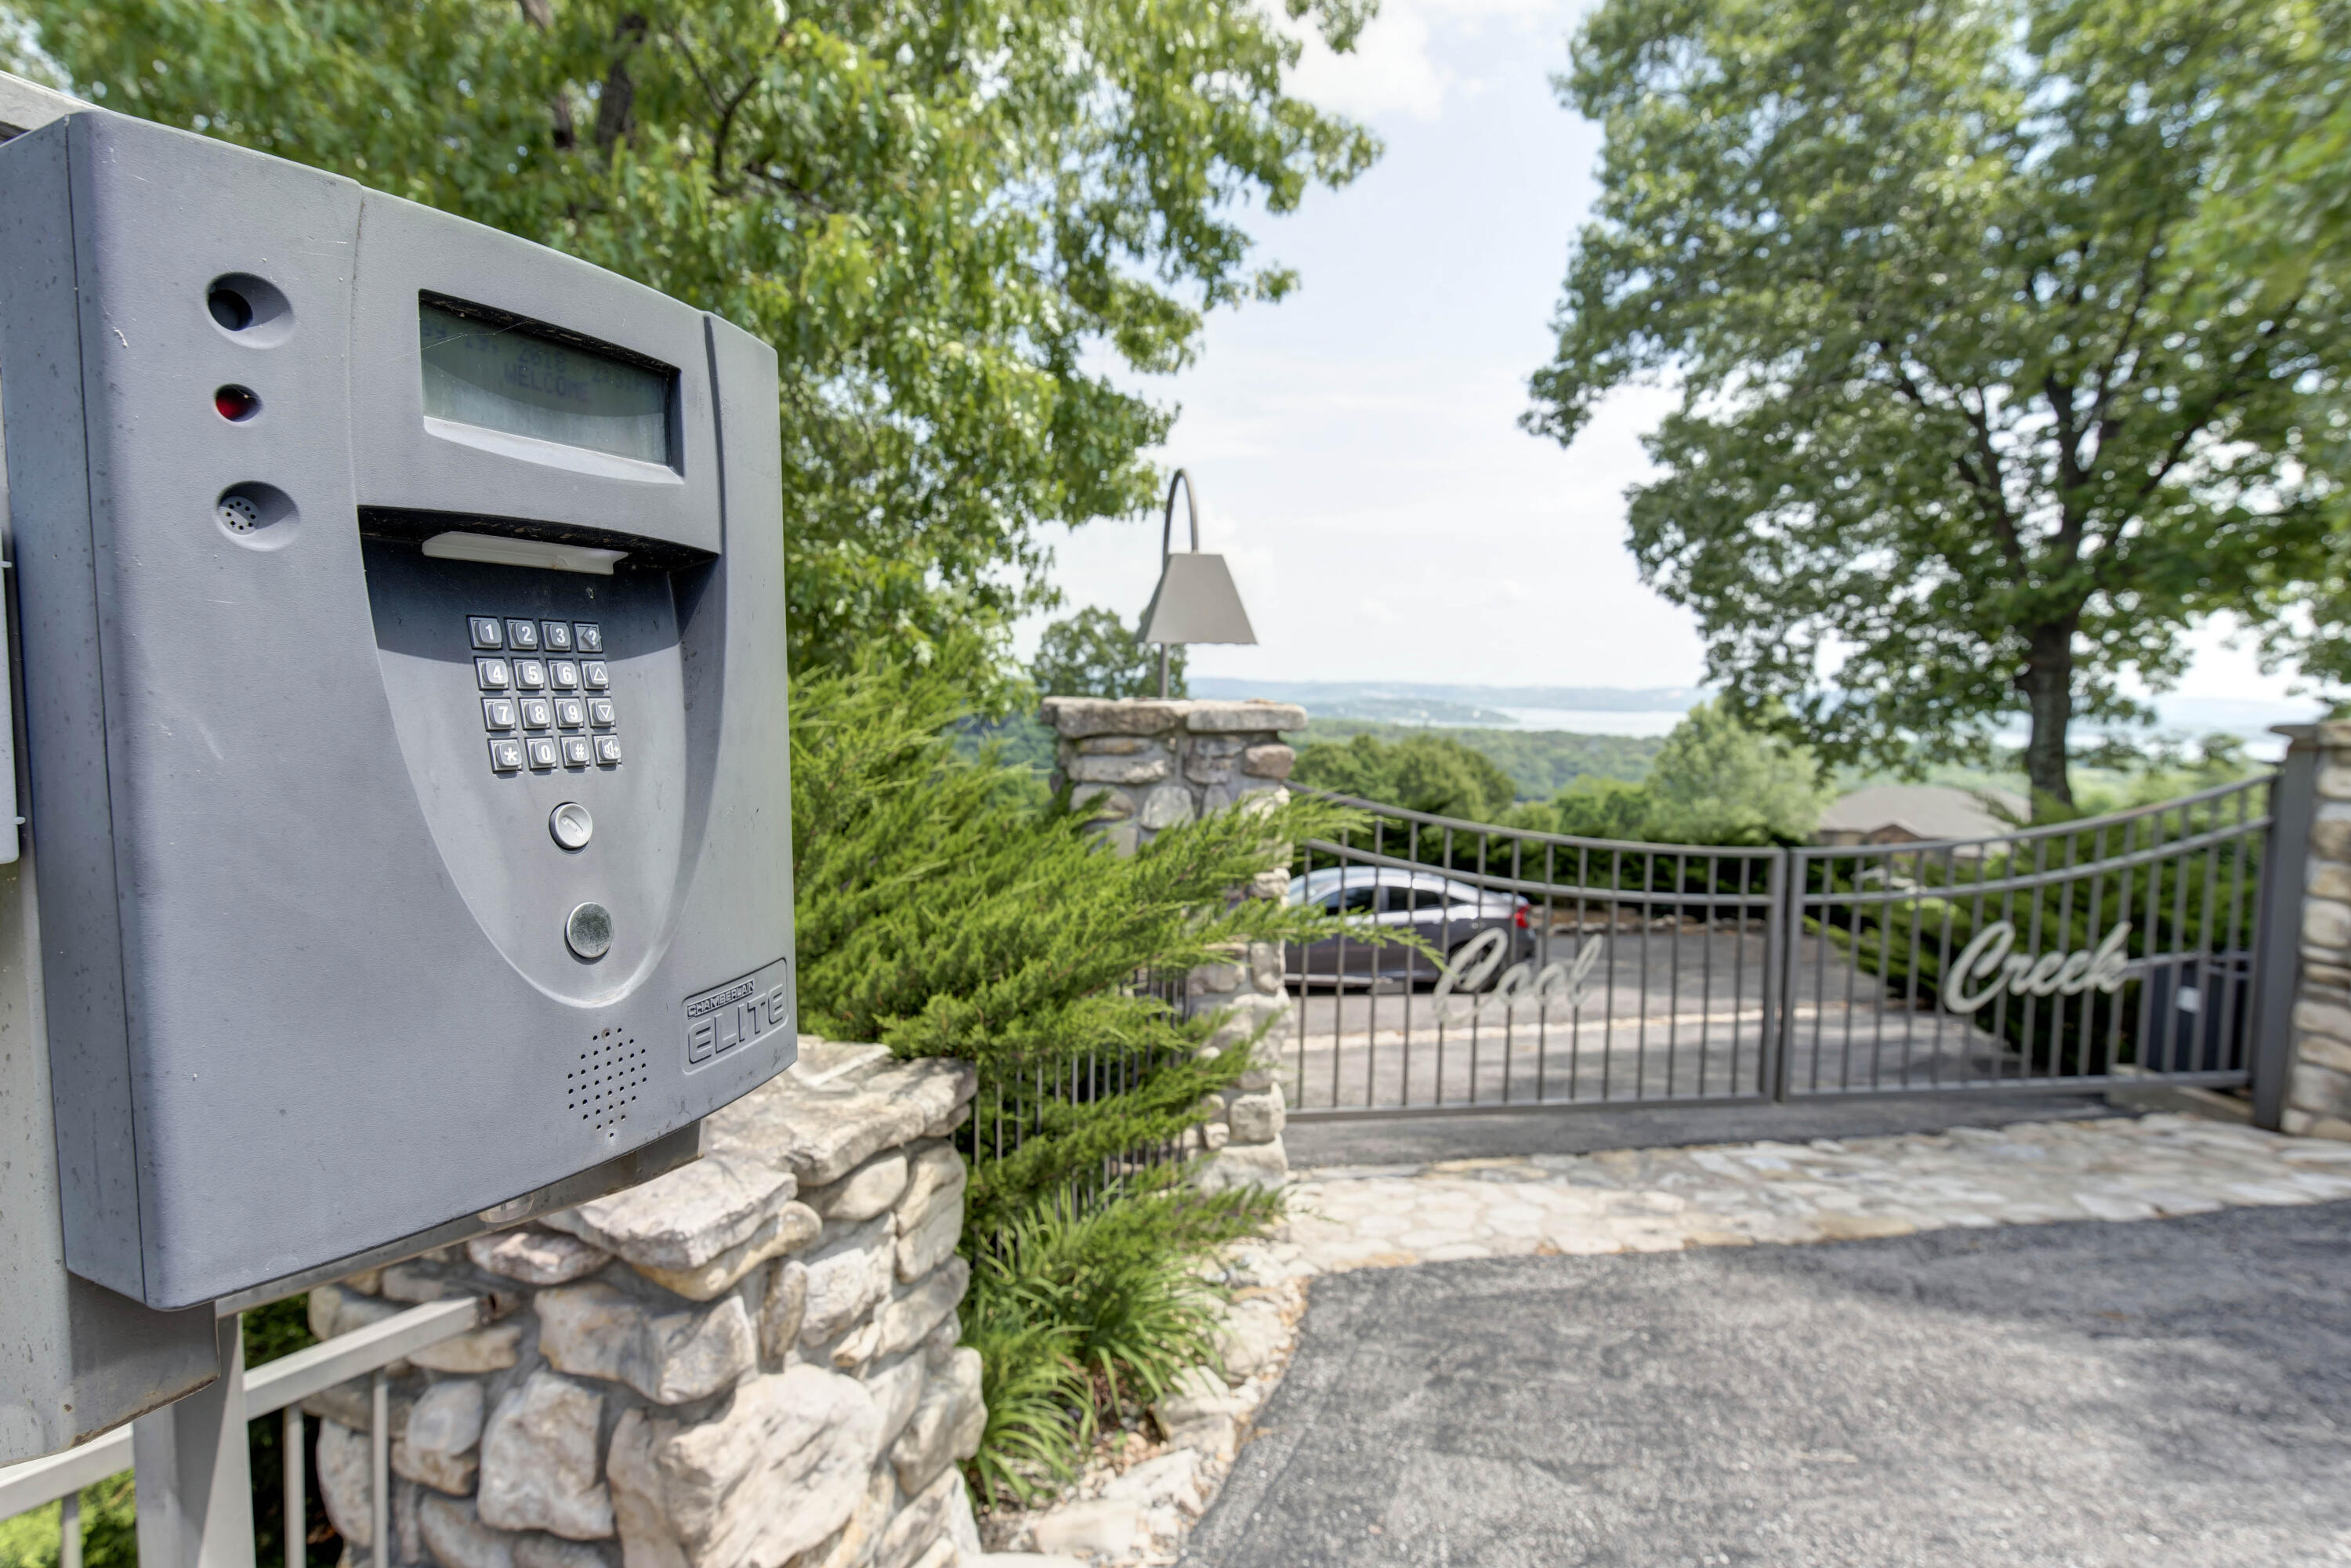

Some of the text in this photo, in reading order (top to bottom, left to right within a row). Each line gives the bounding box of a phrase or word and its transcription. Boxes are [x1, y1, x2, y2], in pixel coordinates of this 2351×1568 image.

[504, 362, 589, 400] WELCOME
[485, 624, 597, 646] 1 2 3 ?
[492, 665, 572, 682] 4 5 6
[498, 704, 578, 722] 7 8 9
[540, 745, 551, 760] 0
[574, 743, 585, 759] #
[1943, 919, 2133, 1015] Creek
[687, 980, 755, 1018] CHAMBERLAIN
[687, 983, 784, 1065] ELITE
